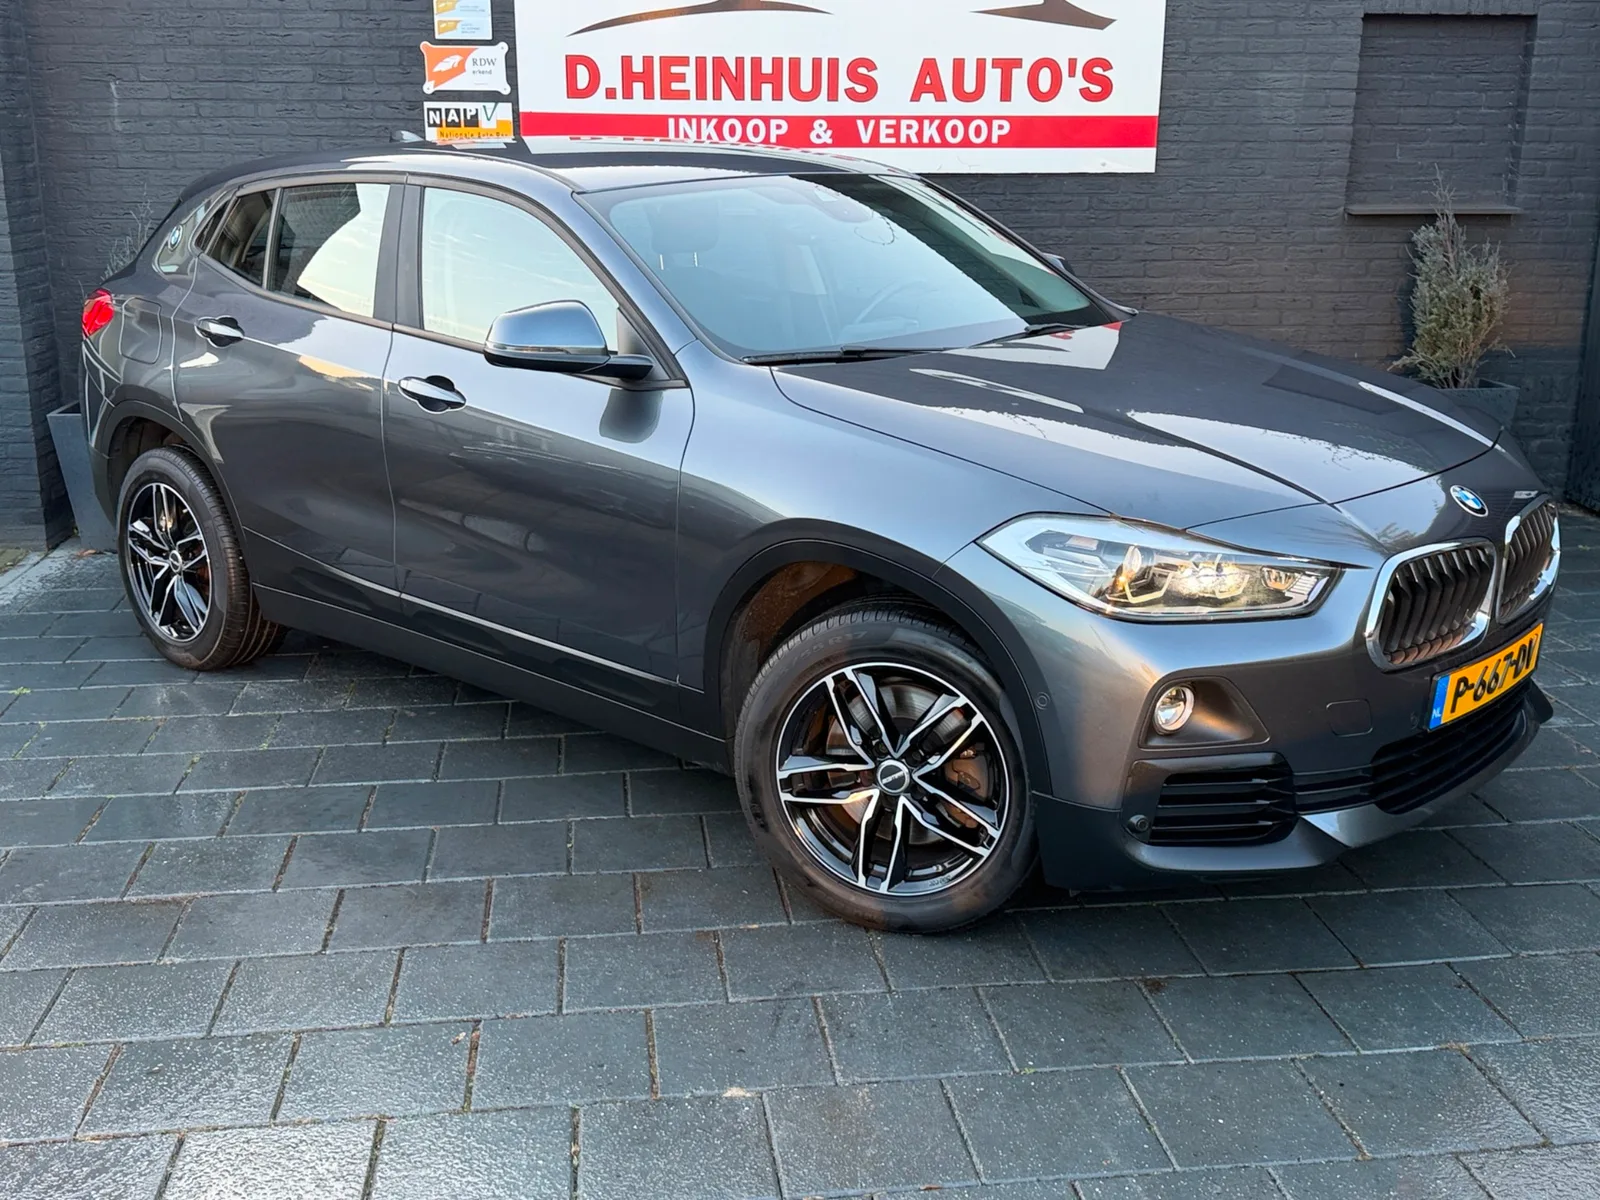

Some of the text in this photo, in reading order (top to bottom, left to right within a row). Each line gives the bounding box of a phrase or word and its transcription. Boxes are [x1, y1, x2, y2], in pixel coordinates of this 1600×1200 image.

[472, 57, 497, 67] RDW
[565, 54, 1114, 103] D.HEINHUIS AUTO'S
[667, 116, 1012, 145] INKOOP & VERKOOP
[1432, 706, 1442, 720] NL
